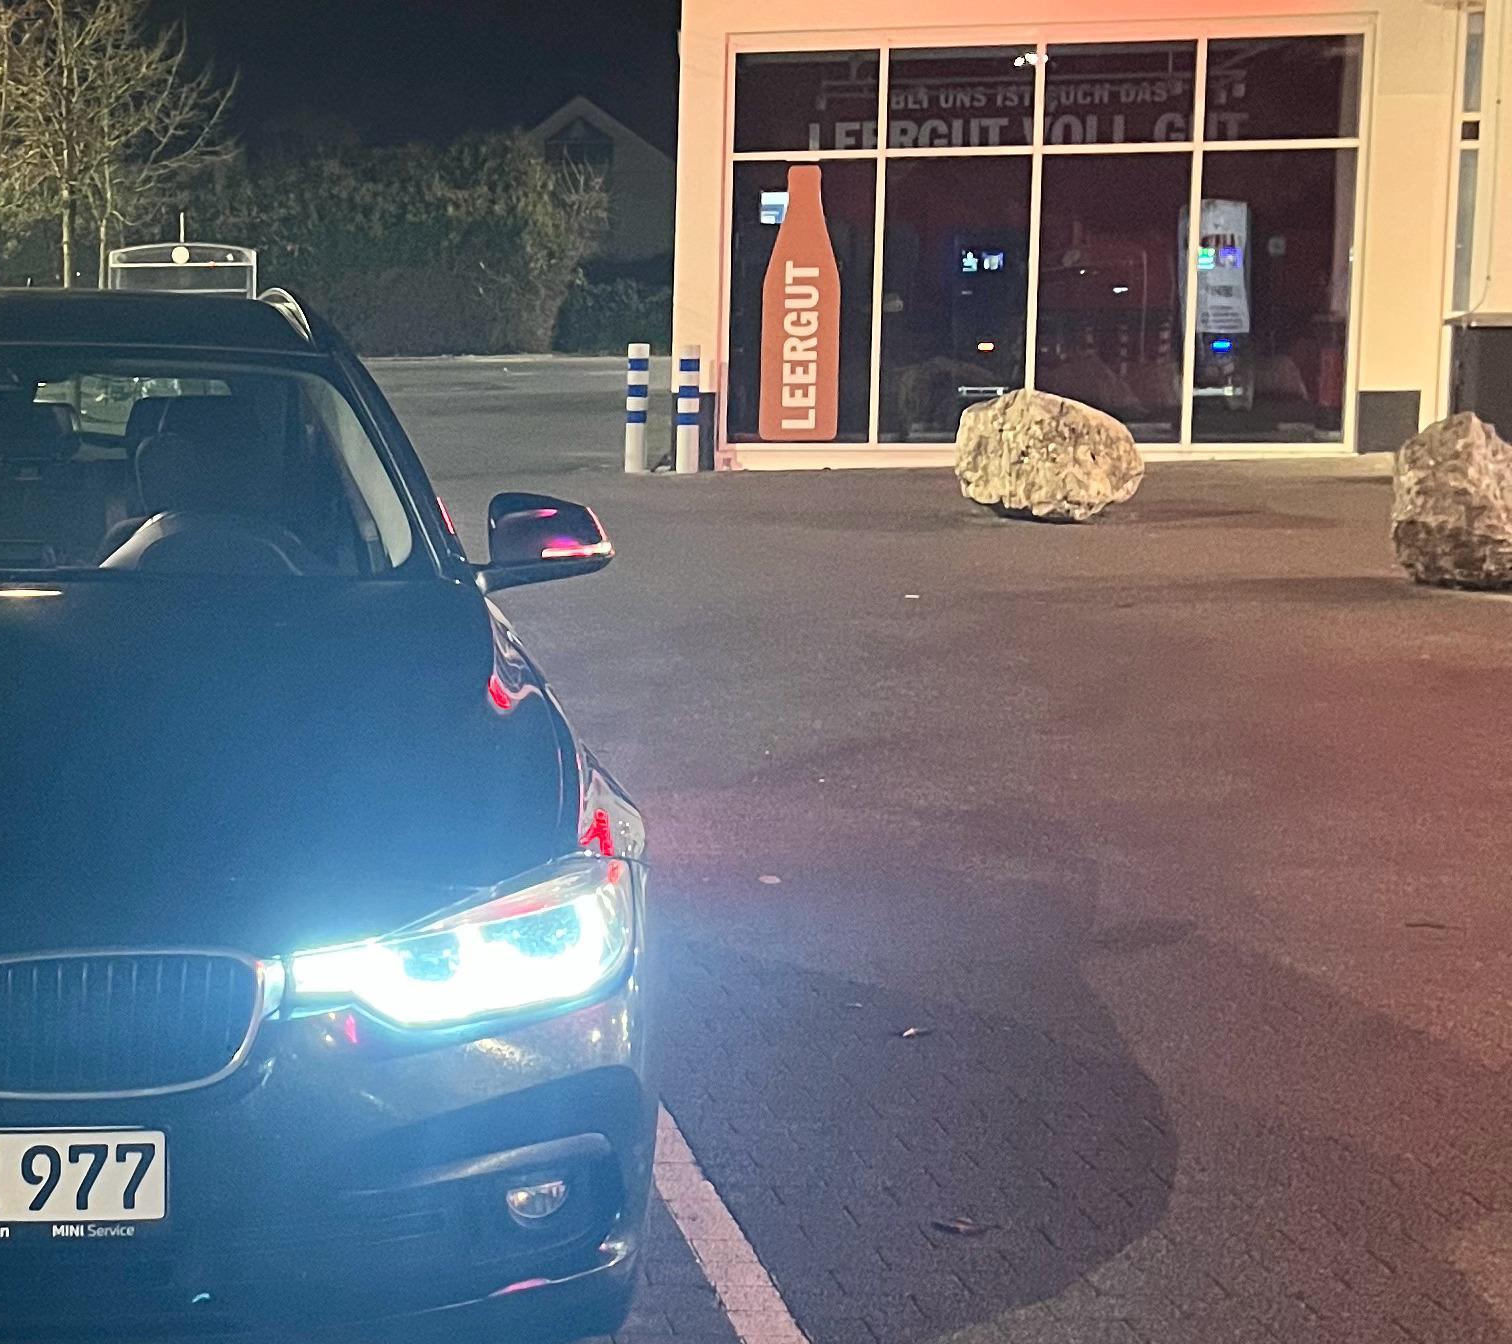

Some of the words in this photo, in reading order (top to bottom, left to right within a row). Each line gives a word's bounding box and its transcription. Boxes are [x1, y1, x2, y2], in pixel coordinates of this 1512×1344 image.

[940, 86, 987, 109] UNS
[995, 85, 1034, 107] IST
[1120, 81, 1169, 104] DAS
[781, 260, 820, 430] LEERGUT
[21, 1143, 156, 1211] 977
[52, 1224, 85, 1238] MINI
[87, 1224, 136, 1238] Service
